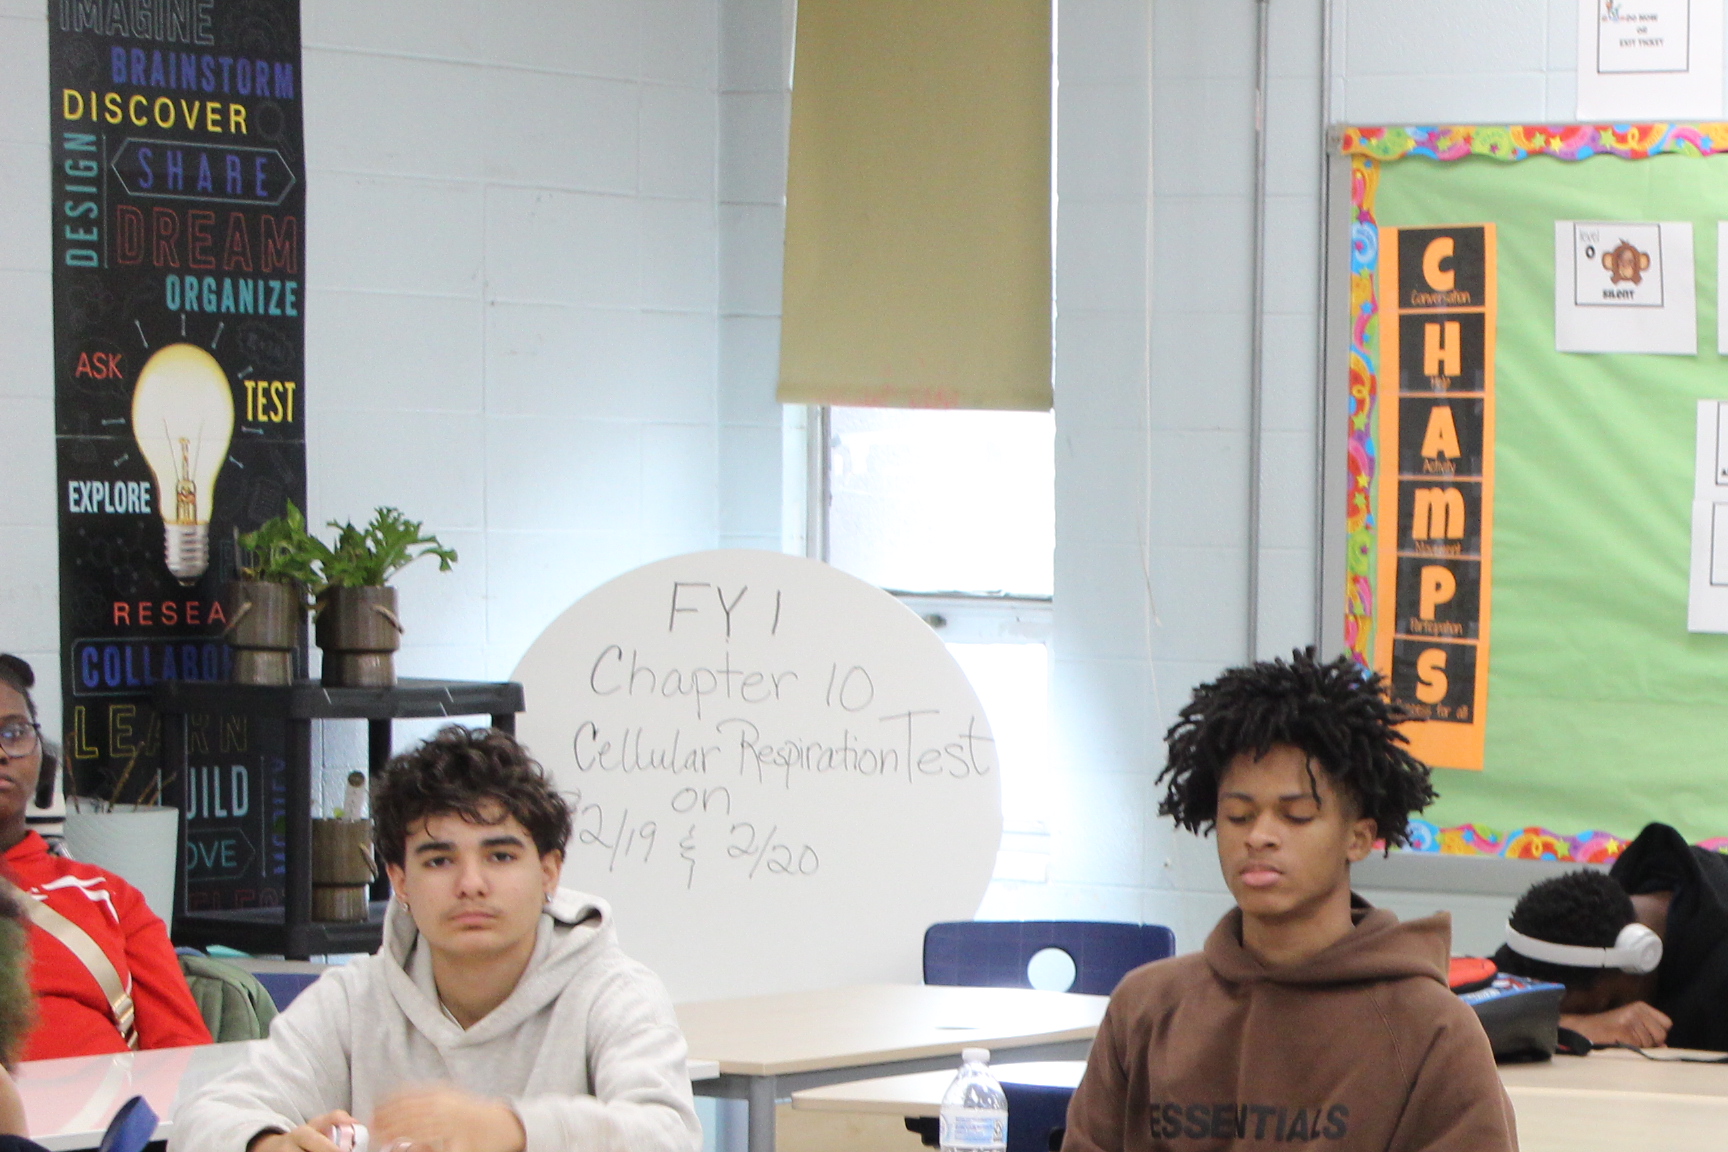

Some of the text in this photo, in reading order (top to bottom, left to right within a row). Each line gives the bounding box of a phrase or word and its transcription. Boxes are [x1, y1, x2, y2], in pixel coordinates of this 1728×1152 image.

[59, 0, 215, 46] IMAGINE
[110, 46, 294, 98] BRAINSTORM
[62, 88, 248, 134] DISCOVER
[138, 147, 269, 198] SHARE
[65, 132, 98, 268] DESIGN
[116, 205, 298, 274] DREAM
[165, 274, 298, 317] ORGANIZE
[75, 352, 123, 380] ASK
[244, 380, 296, 423] TEST
[68, 480, 152, 514] EXPLORE
[113, 601, 227, 625] RESEA
[81, 644, 233, 689] COLLABO
[589, 644, 875, 720] Chapter 10
[573, 721, 721, 776] Cellular
[879, 710, 995, 784] Test
[671, 786, 730, 815] on
[727, 823, 820, 879] 2/20
[1149, 1103, 1350, 1143] ESSENTIALS
